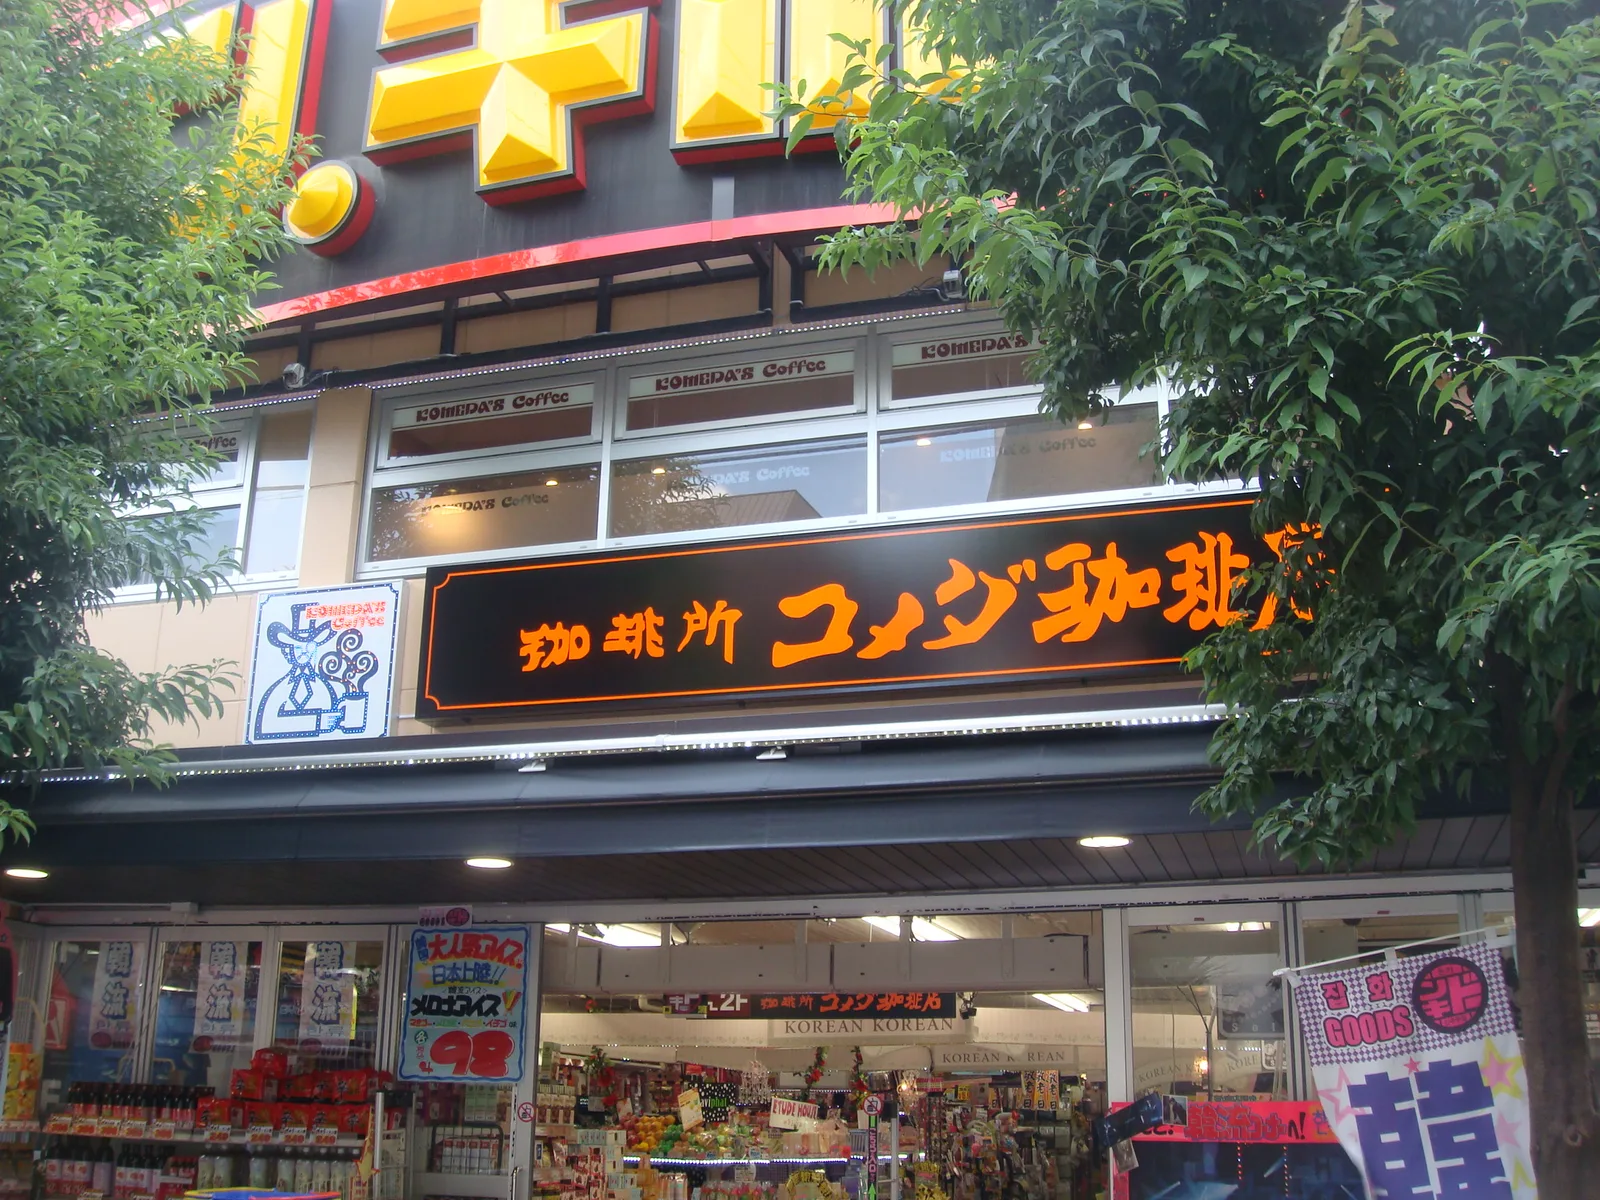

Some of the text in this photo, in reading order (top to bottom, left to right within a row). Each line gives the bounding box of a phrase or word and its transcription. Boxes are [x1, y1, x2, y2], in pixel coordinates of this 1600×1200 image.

[921, 334, 1028, 359] KOMEDA'S
[655, 360, 826, 391] KOMEDA'S Coffee
[416, 391, 569, 423] KOMEDA'S Coffee
[519, 599, 743, 672] 珈琲所
[784, 1017, 953, 1034] KOREAN KOREAN
[1323, 1005, 1414, 1047] GOODS
[429, 1030, 515, 1077] 98
[943, 1051, 1065, 1065] KOREAN KREAN
